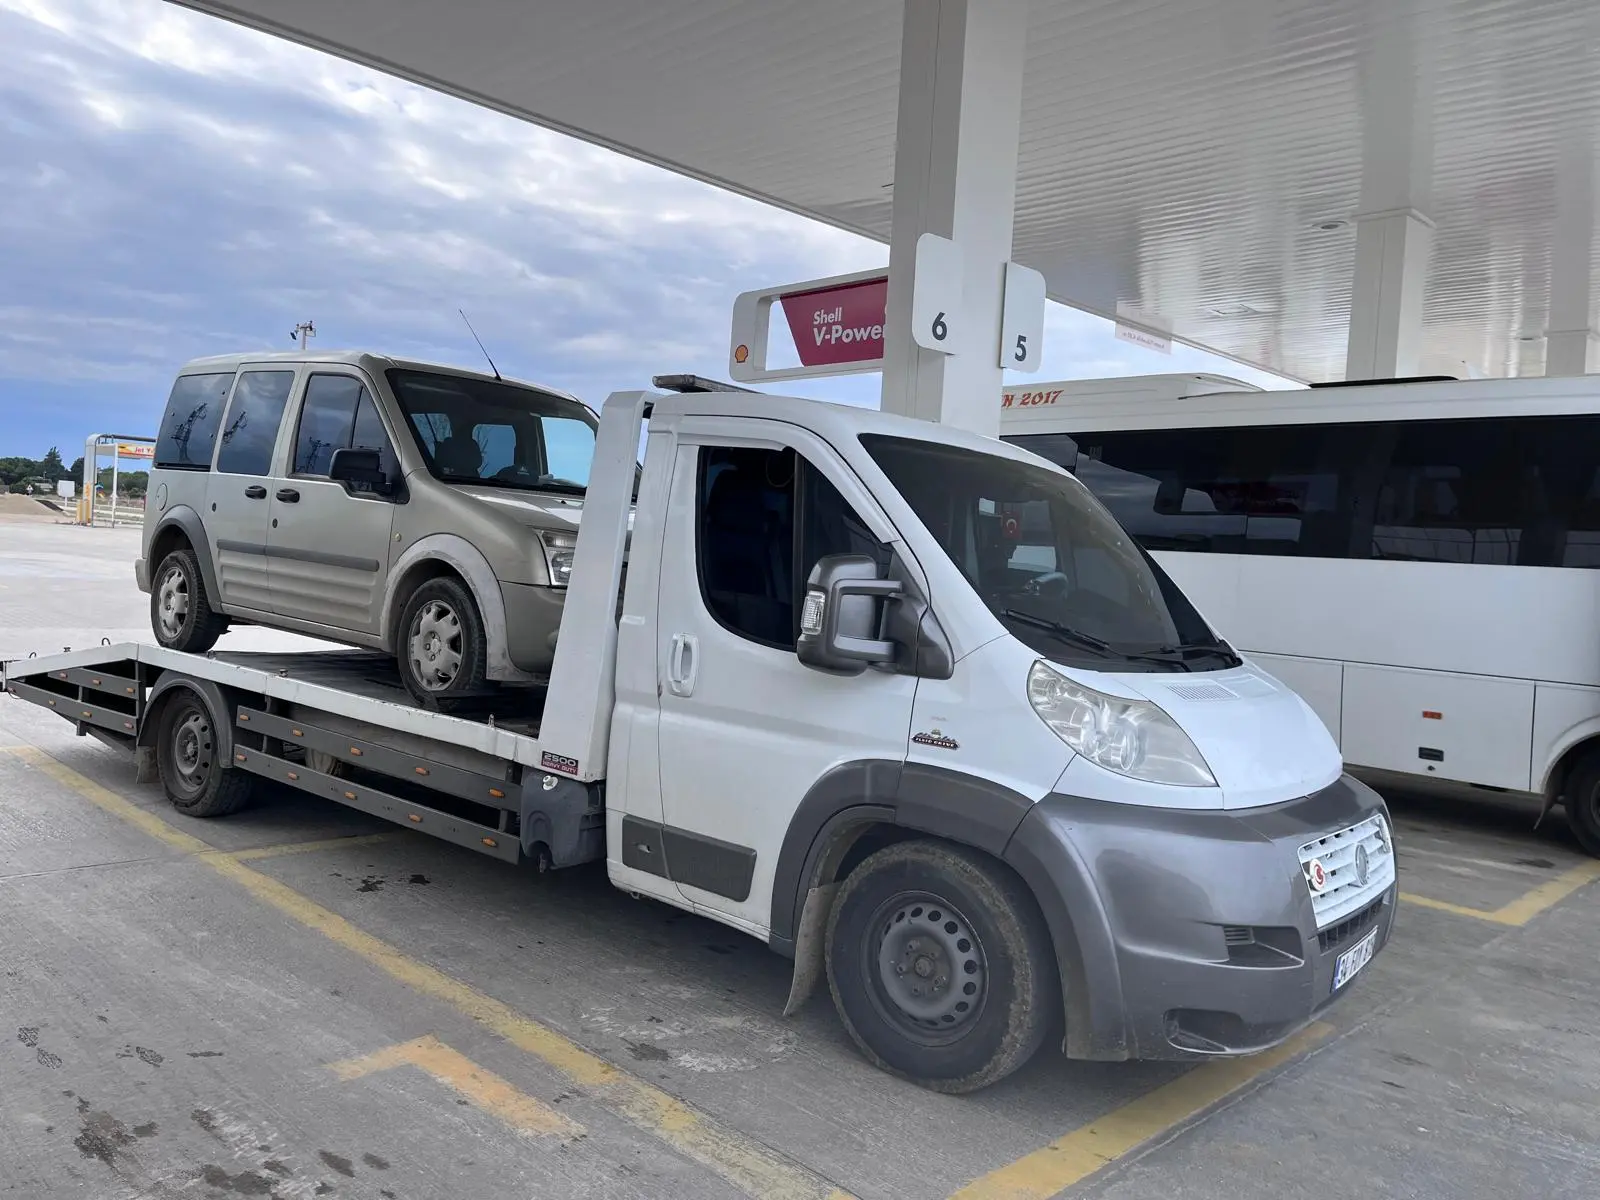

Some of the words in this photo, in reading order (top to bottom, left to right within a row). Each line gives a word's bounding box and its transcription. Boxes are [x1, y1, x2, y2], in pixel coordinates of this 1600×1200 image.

[813, 306, 843, 325] Shell
[931, 312, 948, 341] 6
[1014, 335, 1027, 362] 5
[1019, 389, 1064, 406] 2017
[544, 753, 576, 766] 2500
[561, 765, 577, 774] DUTY
